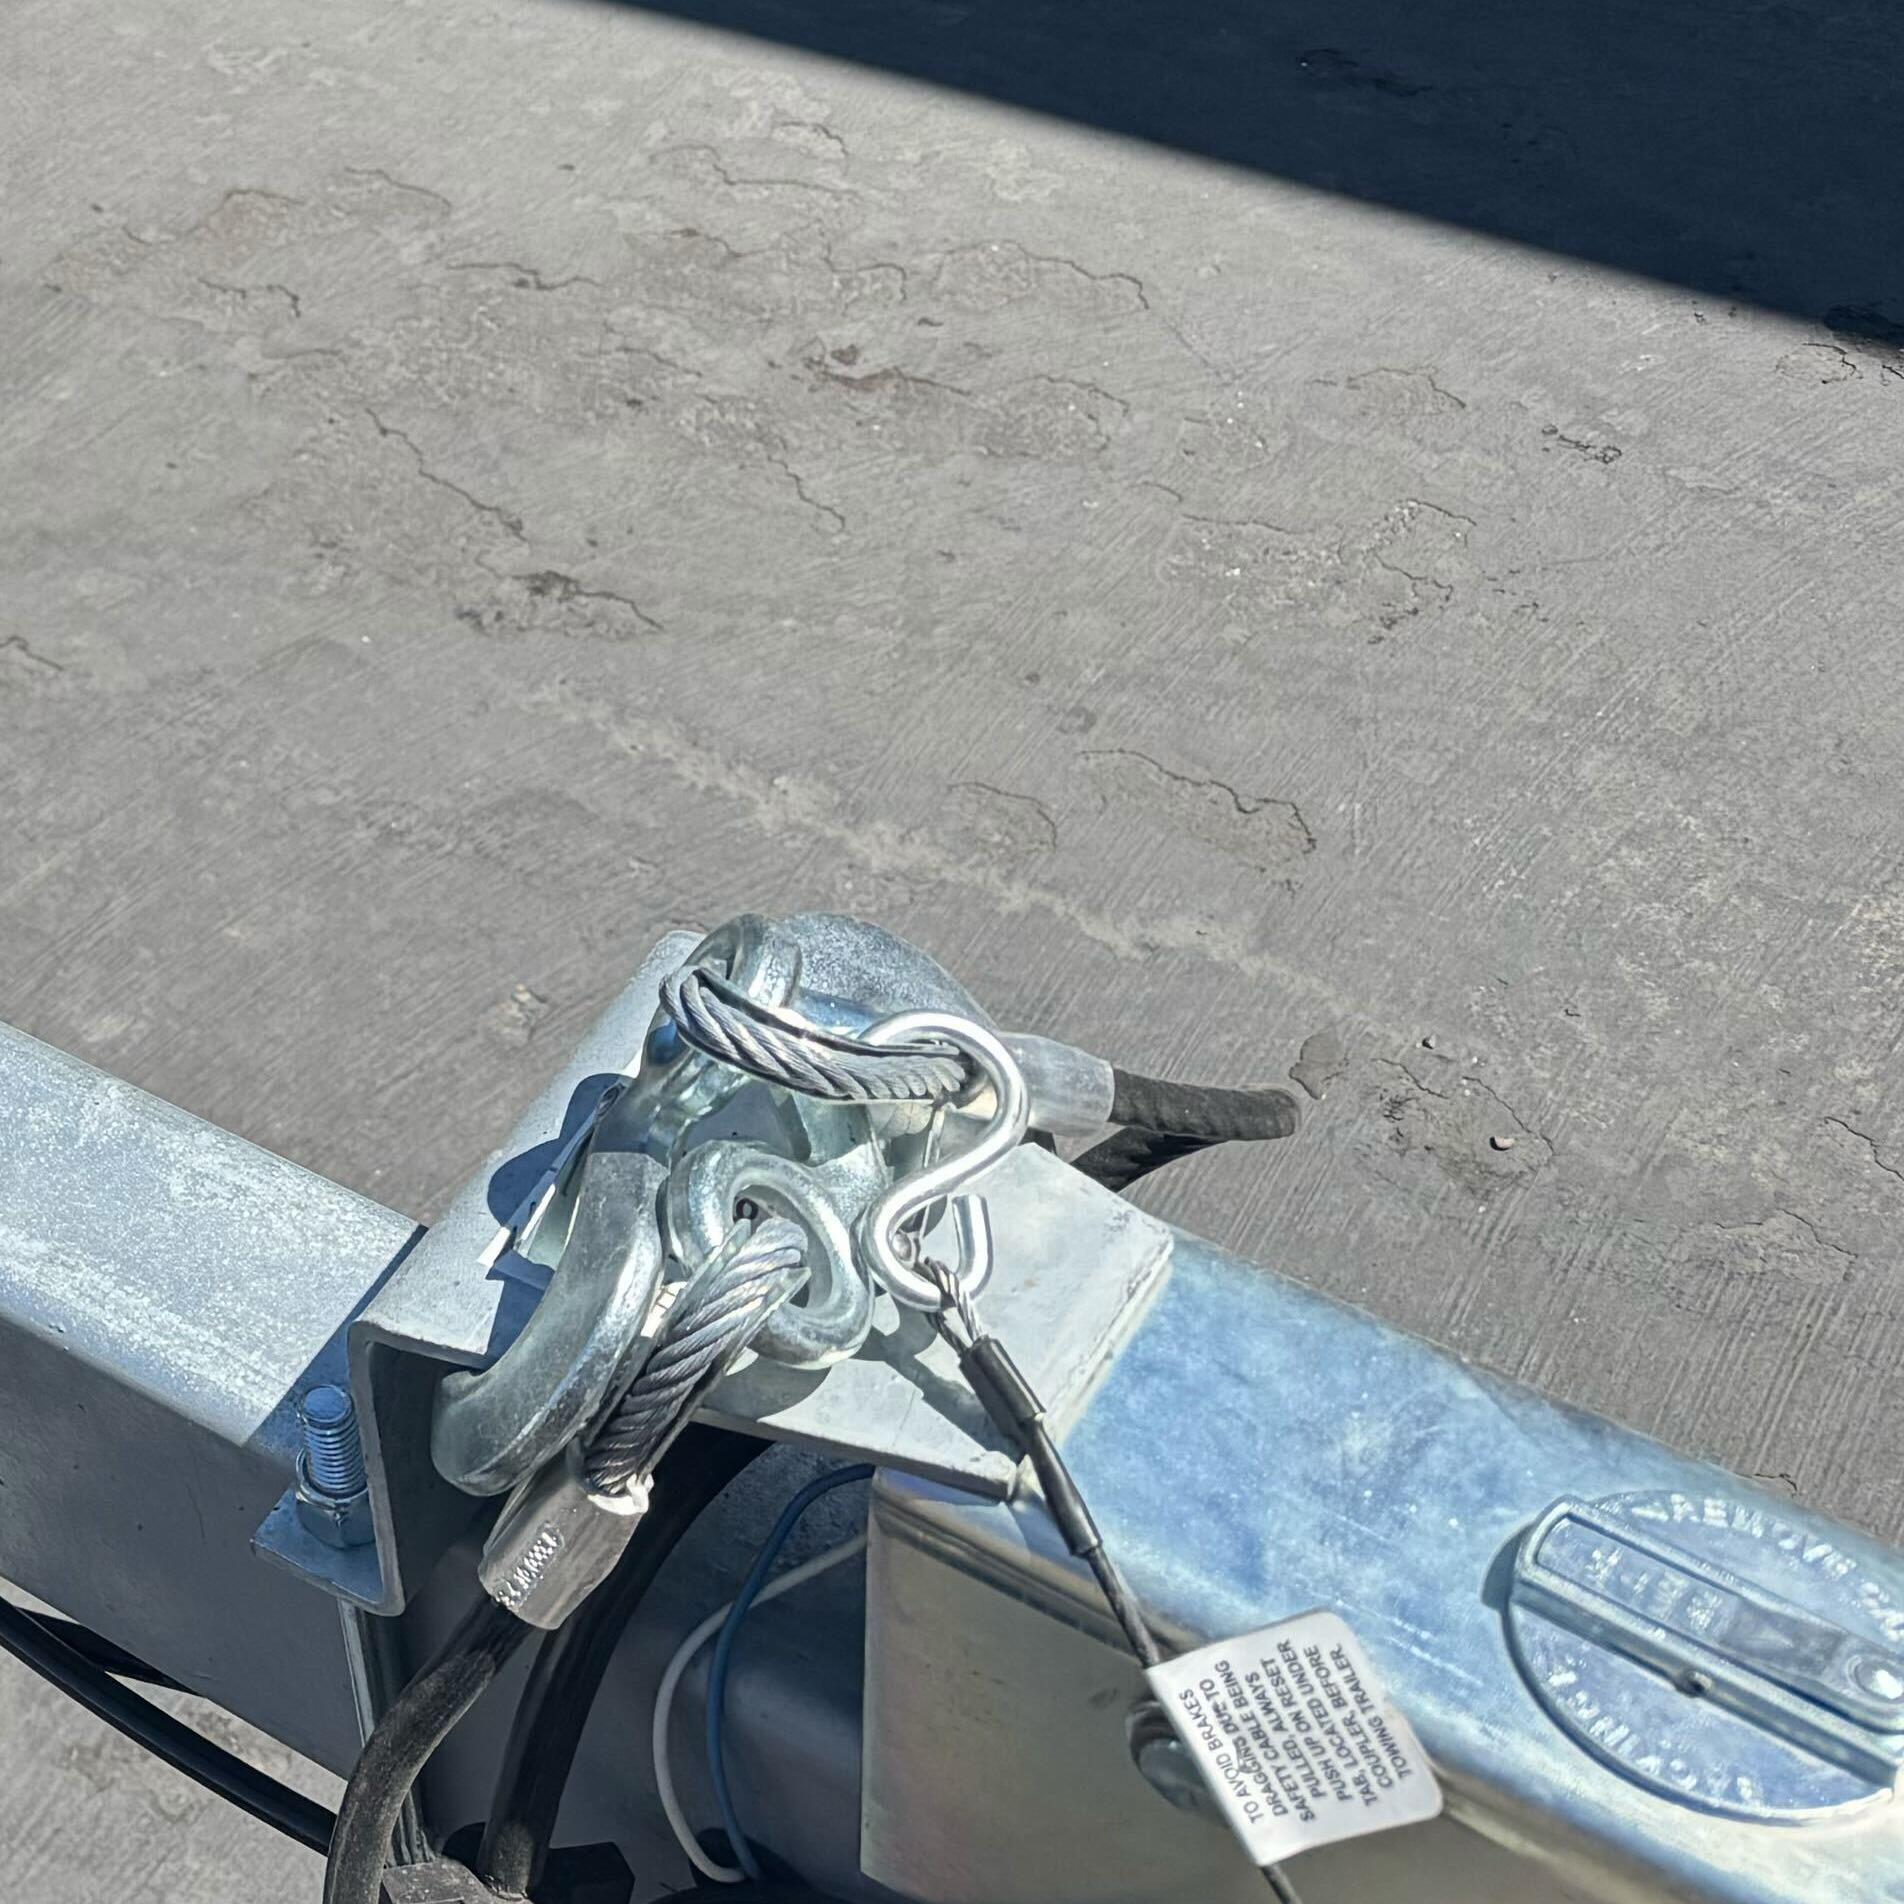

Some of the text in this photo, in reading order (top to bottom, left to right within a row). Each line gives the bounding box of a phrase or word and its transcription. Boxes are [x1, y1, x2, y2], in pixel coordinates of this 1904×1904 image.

[1180, 1688, 1264, 1824] TO AVOID BRAKES
[1200, 1678, 1220, 1702] TO
[1214, 1702, 1240, 1736] DUE
[1214, 1660, 1316, 1822] SAFETY CABLE BEING
[1245, 1672, 1326, 1798] PULLED, ALWAYS
[1261, 1657, 1353, 1802] PUSH UP ON RESET
[1278, 1639, 1378, 1806] TAB, LOCATED UNDER
[1303, 1645, 1392, 1789] COUPLER, BEFORE
[1330, 1643, 1412, 1780] TOWING TRAILER.
